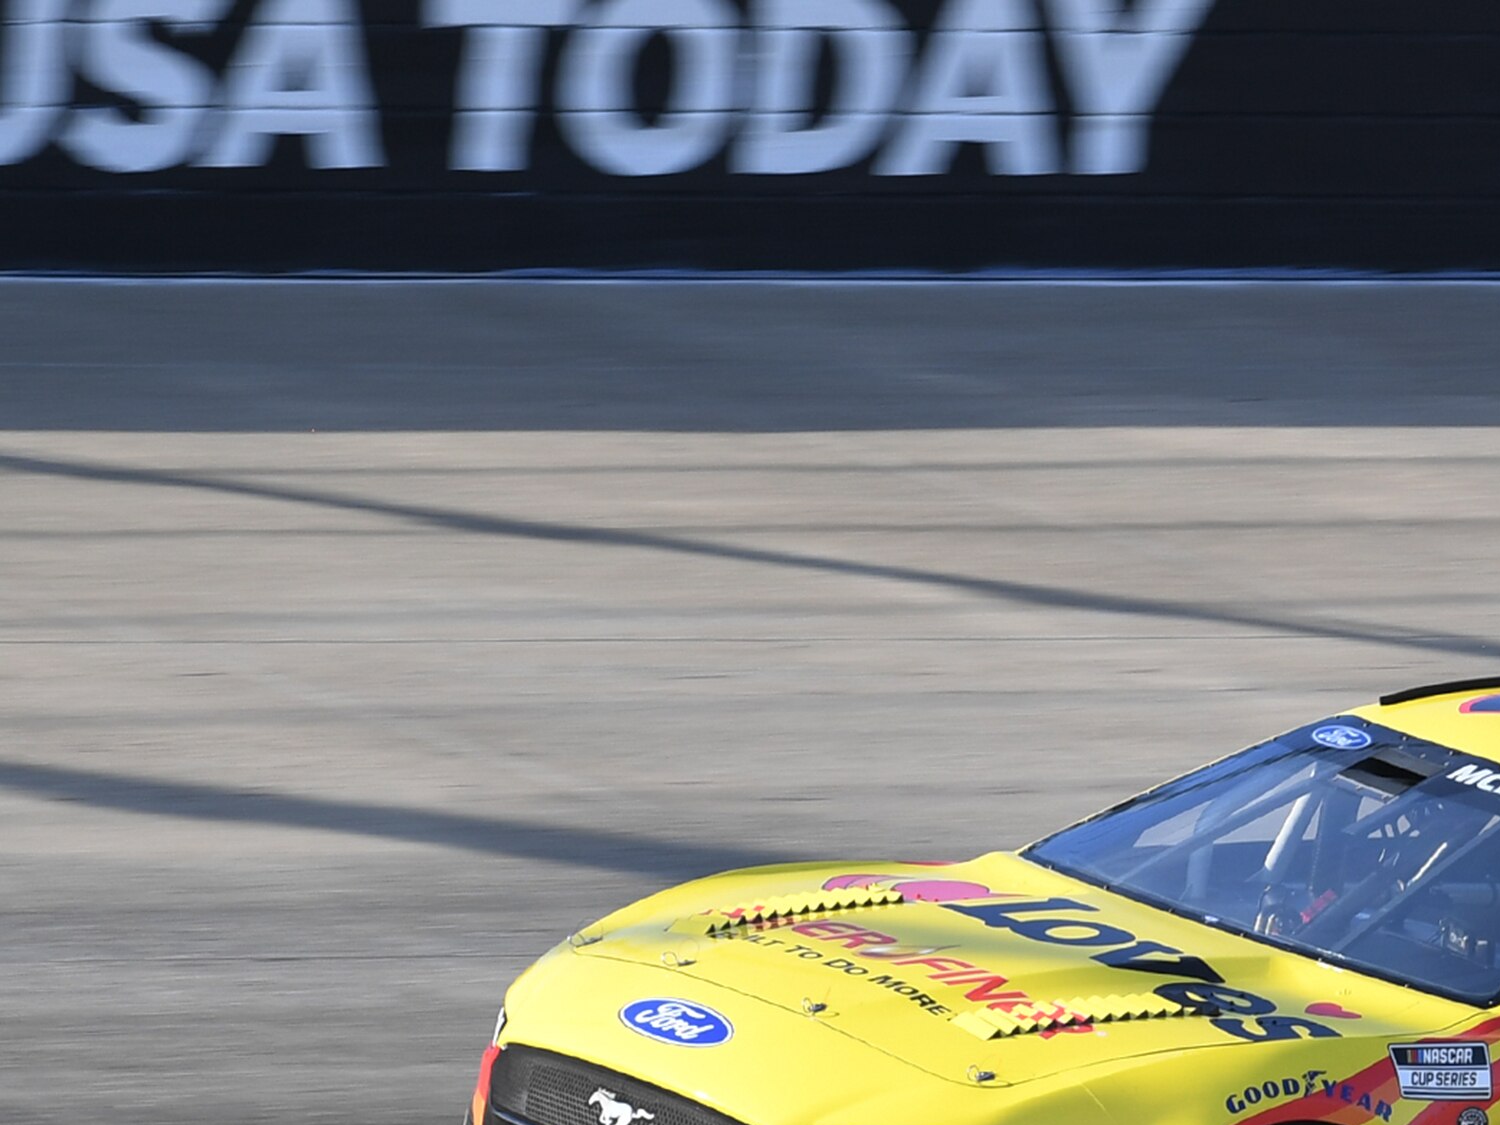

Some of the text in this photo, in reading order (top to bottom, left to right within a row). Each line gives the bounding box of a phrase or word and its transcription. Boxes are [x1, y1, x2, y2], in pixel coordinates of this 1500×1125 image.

[420, 0, 1205, 175] TODAY
[784, 943, 824, 960] TO
[824, 957, 869, 976] DO
[632, 1001, 717, 1041] Ford
[1421, 1047, 1474, 1064] NASCAR
[1411, 1071, 1478, 1087] CUP SERIES
